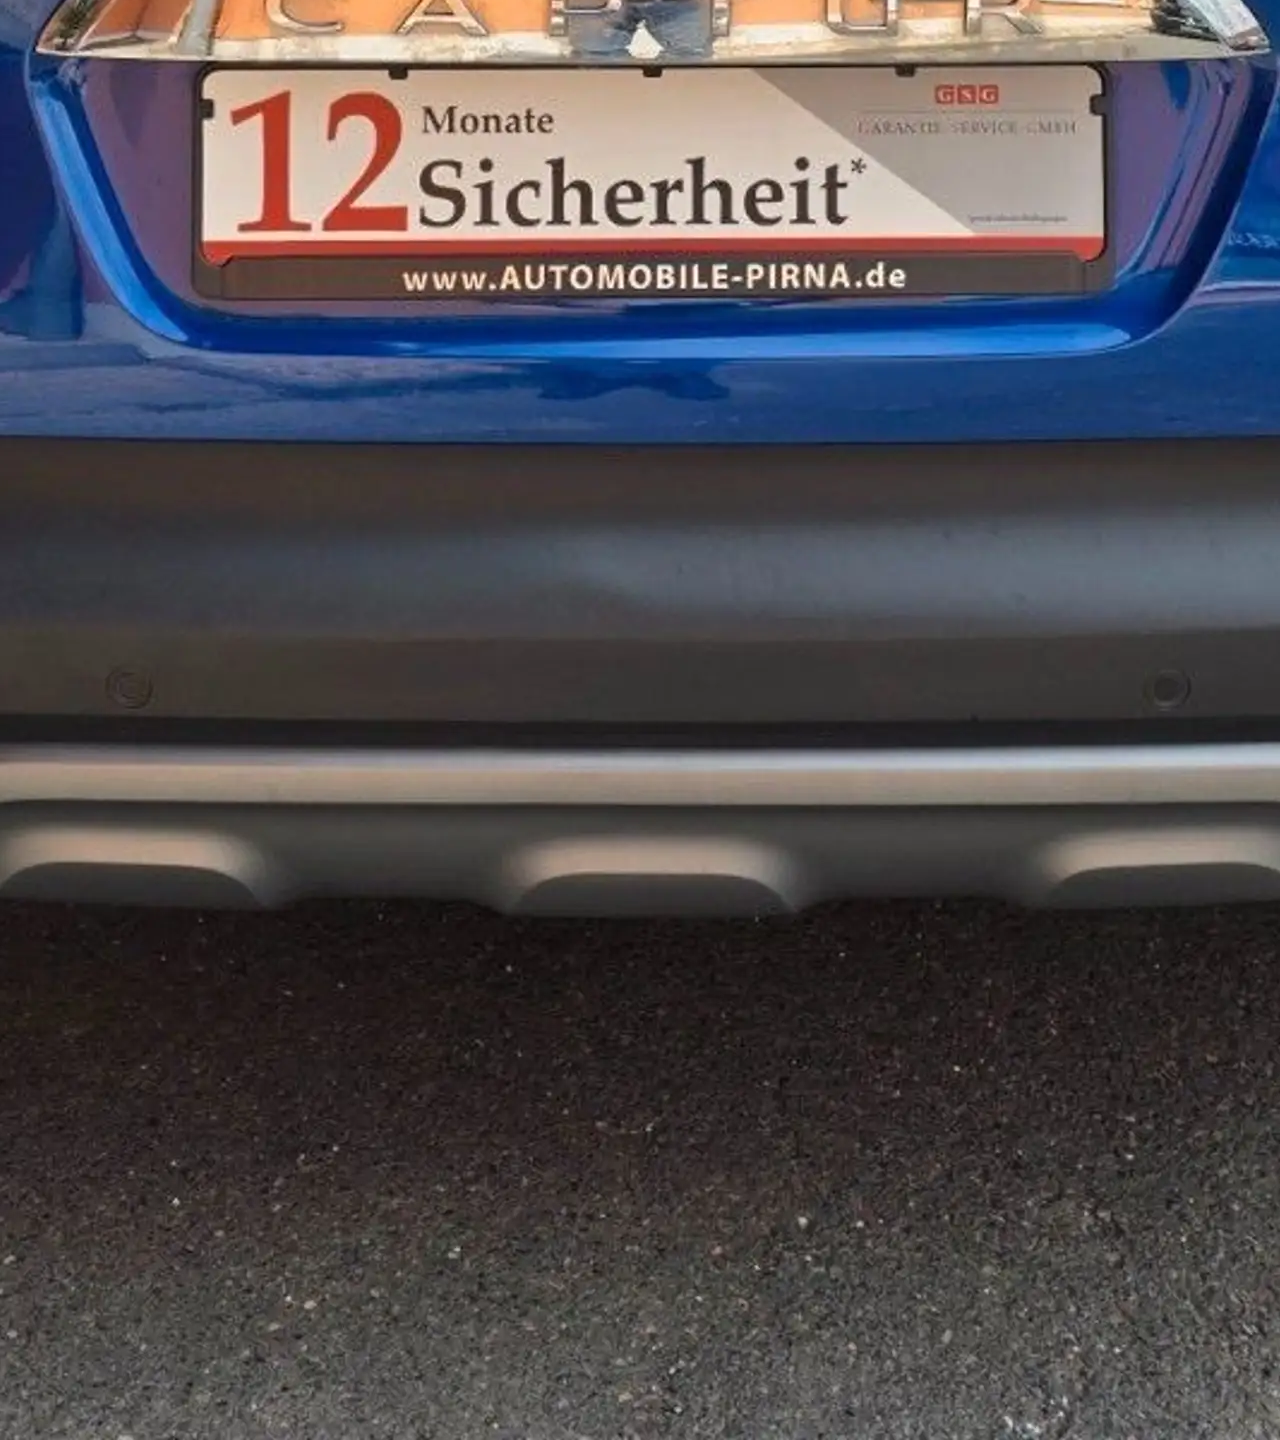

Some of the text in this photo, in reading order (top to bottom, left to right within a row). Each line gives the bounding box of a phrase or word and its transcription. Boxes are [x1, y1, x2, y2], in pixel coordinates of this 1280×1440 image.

[936, 85, 999, 104] GSG
[421, 105, 554, 134] Monate
[230, 88, 409, 233] 12
[402, 261, 907, 291] www.AUTOMOBILE-PIRNA.de
